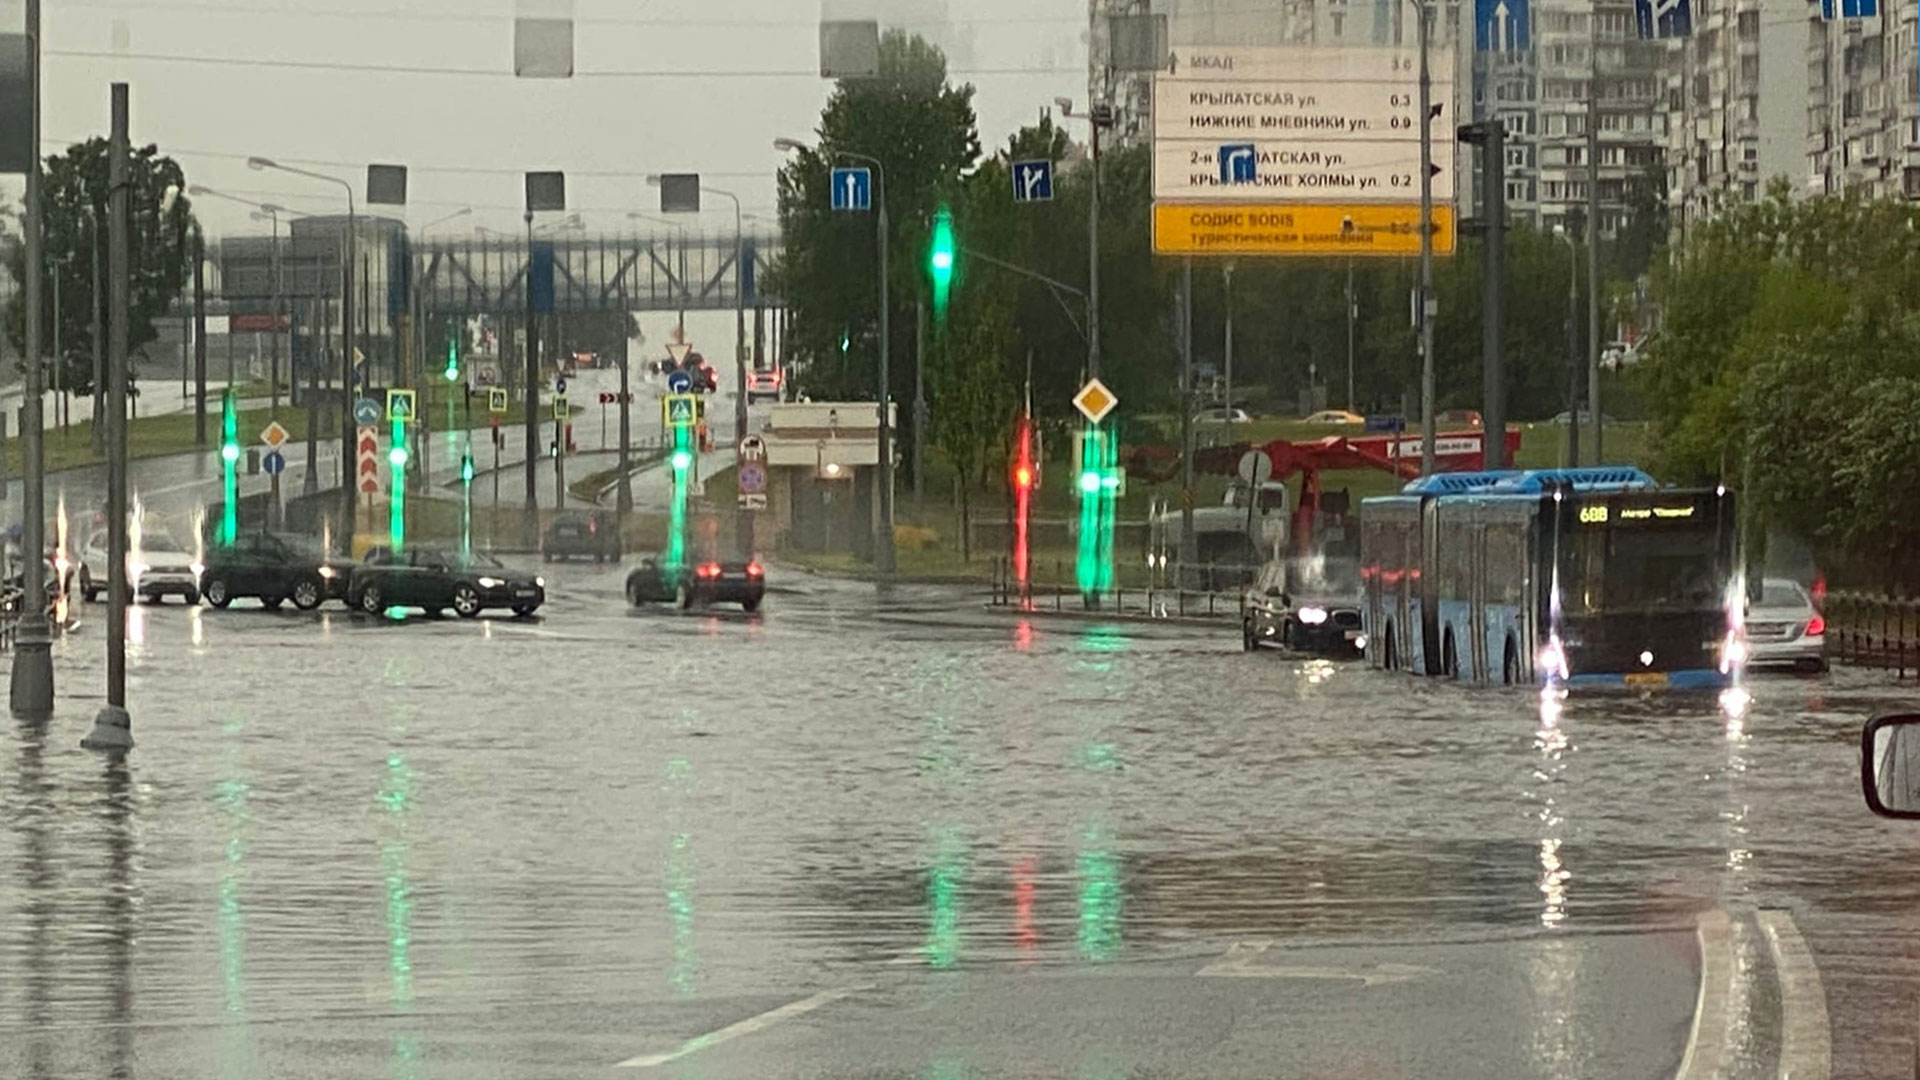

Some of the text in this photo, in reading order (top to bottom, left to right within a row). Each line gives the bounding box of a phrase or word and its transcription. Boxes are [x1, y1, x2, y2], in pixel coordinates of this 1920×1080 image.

[1190, 56, 1234, 71] МКАД
[1190, 91, 1294, 105] КРЫЛАТСКАЯ
[1390, 94, 1411, 107] 0.3
[1190, 115, 1370, 132] НИЖНИЕ МНЕВНИКИ ул.
[1325, 154, 1346, 168] ул.
[1298, 174, 1355, 187] ХОЛМЫ
[1359, 177, 1381, 190] ул.
[1390, 174, 1412, 187] 0.2
[1190, 213, 1244, 227] СОДИС
[1580, 506, 1608, 522] 688
